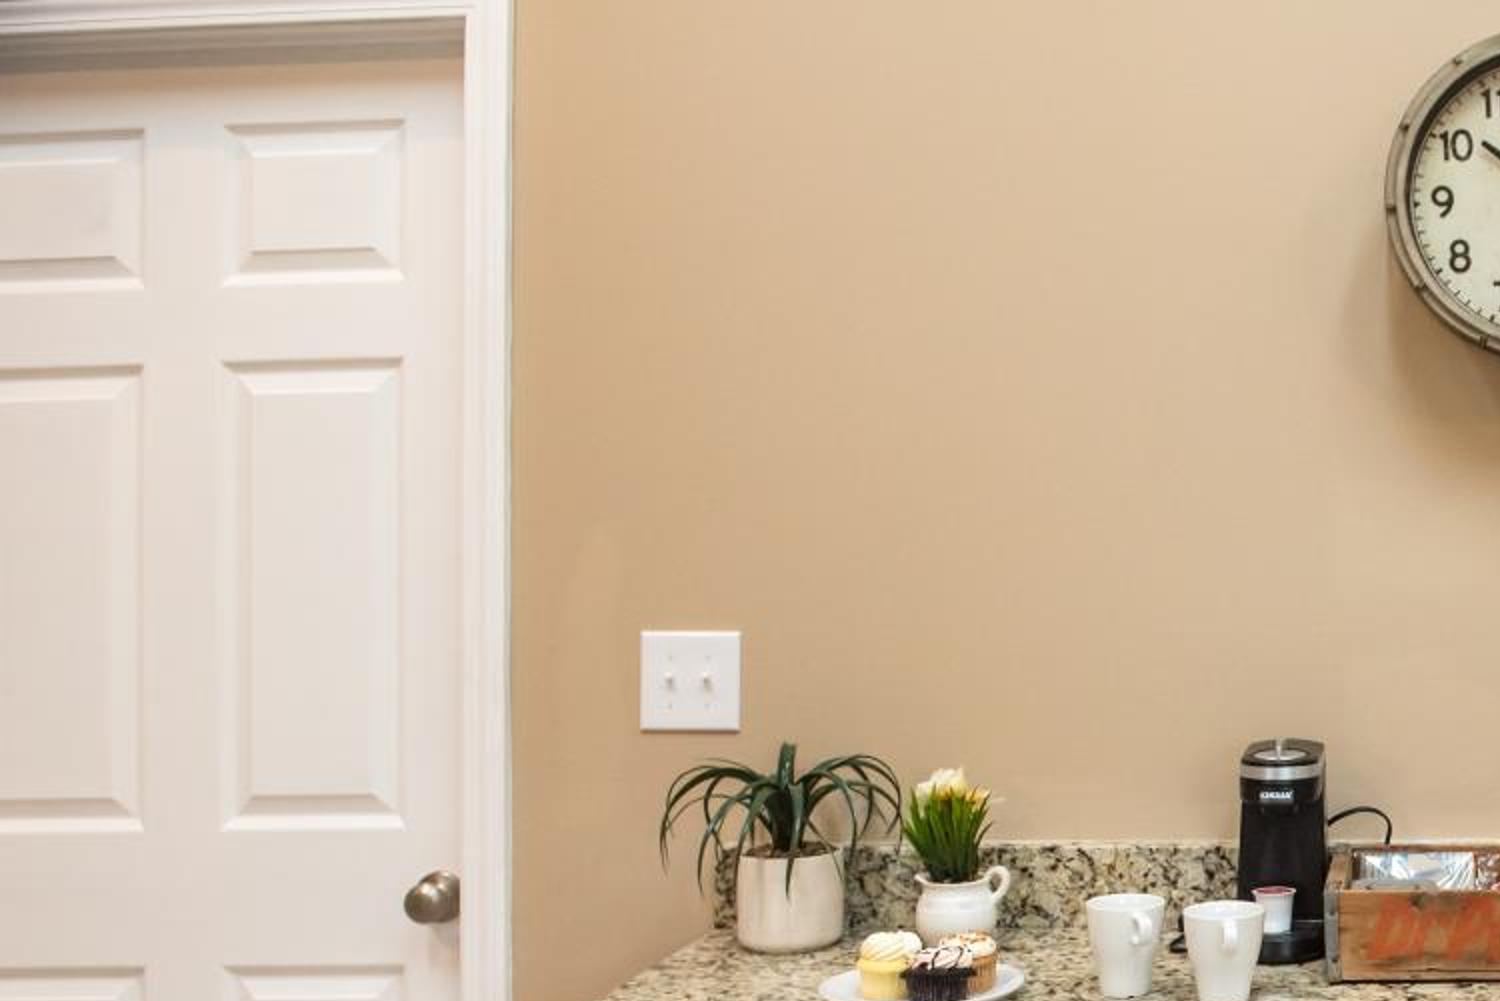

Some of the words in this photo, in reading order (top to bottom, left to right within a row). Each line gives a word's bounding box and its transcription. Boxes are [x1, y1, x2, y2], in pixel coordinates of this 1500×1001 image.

[1438, 128, 1474, 162] 10
[1431, 185, 1454, 218] 9
[1449, 239, 1472, 274] 8
